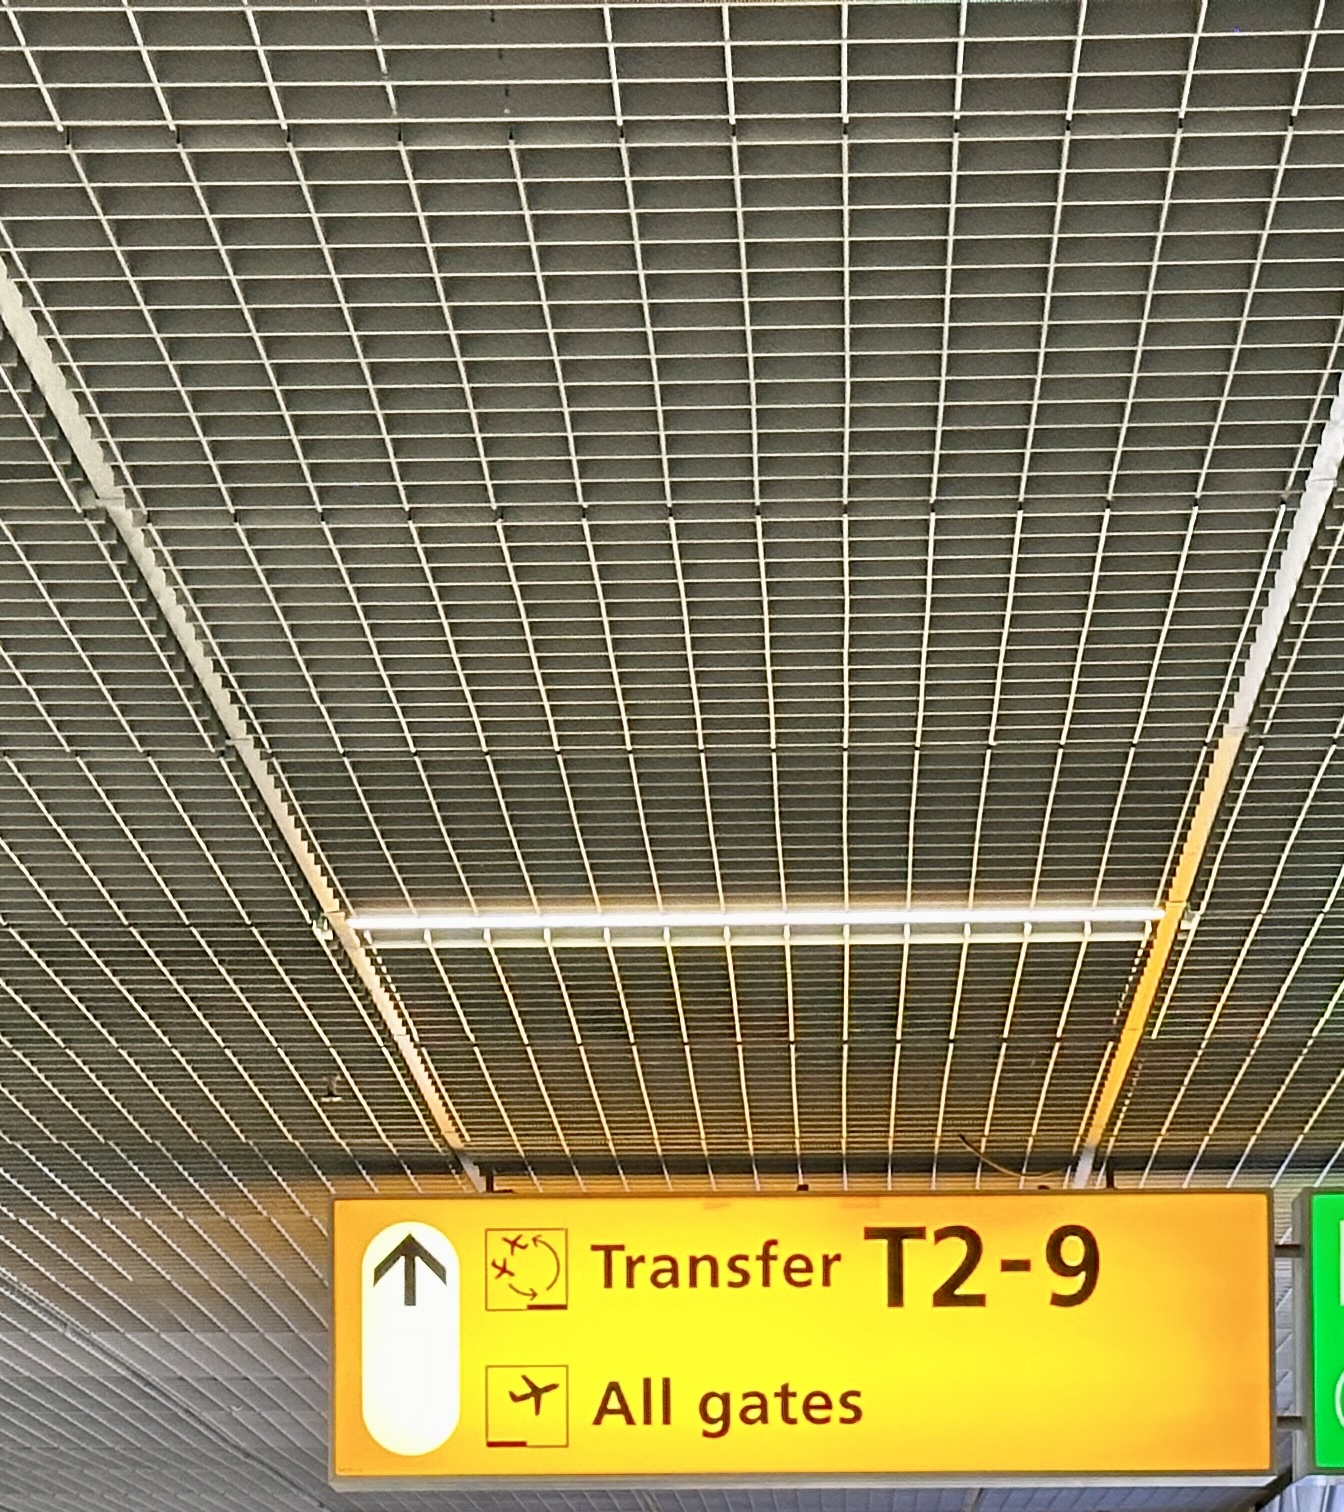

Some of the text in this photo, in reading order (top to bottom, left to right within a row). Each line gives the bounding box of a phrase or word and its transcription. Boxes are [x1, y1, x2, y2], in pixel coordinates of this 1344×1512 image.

[591, 1225, 1100, 1308] Transfer T2-9
[593, 1377, 864, 1439] All gates
